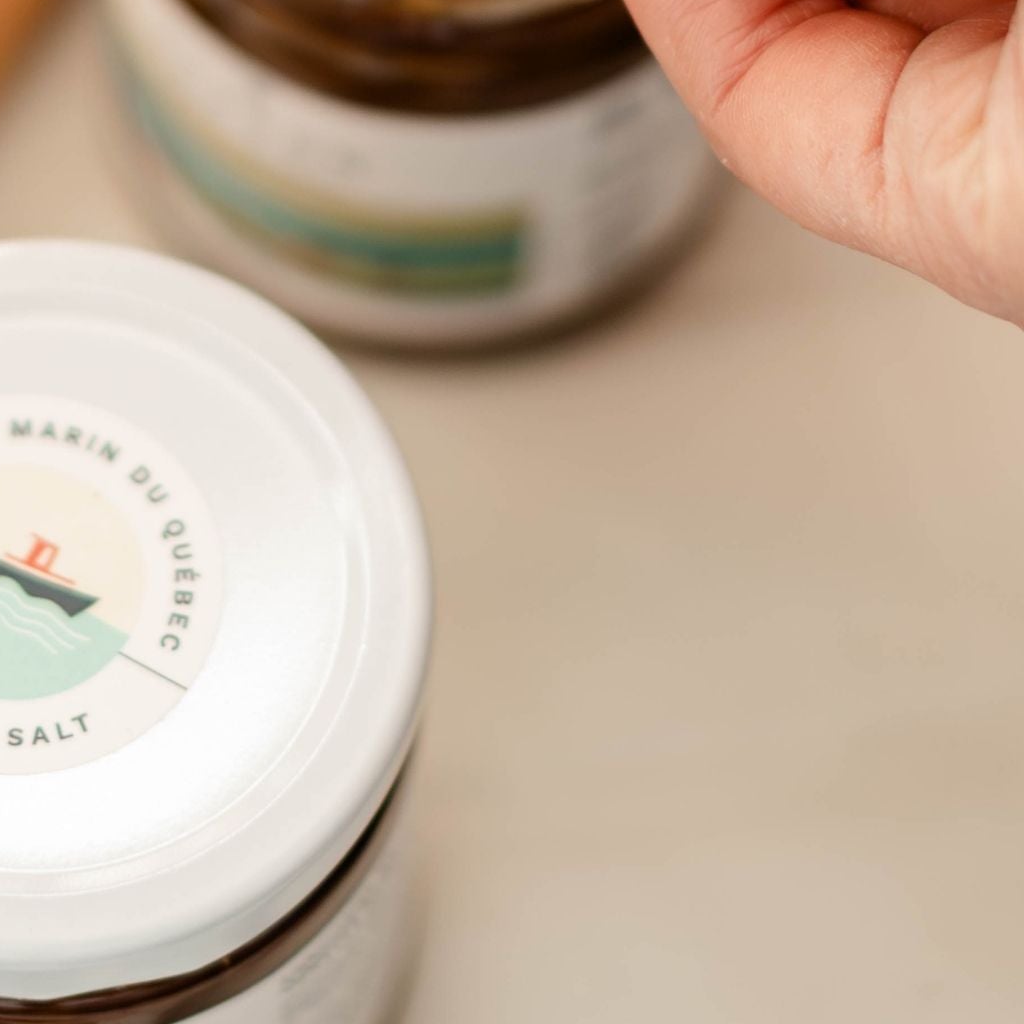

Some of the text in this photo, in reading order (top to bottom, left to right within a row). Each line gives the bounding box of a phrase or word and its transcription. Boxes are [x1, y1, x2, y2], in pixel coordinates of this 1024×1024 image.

[10, 418, 120, 462] MARIN
[129, 466, 169, 503] DU
[160, 519, 200, 652] QUÉBEC
[7, 713, 89, 747] SALT
